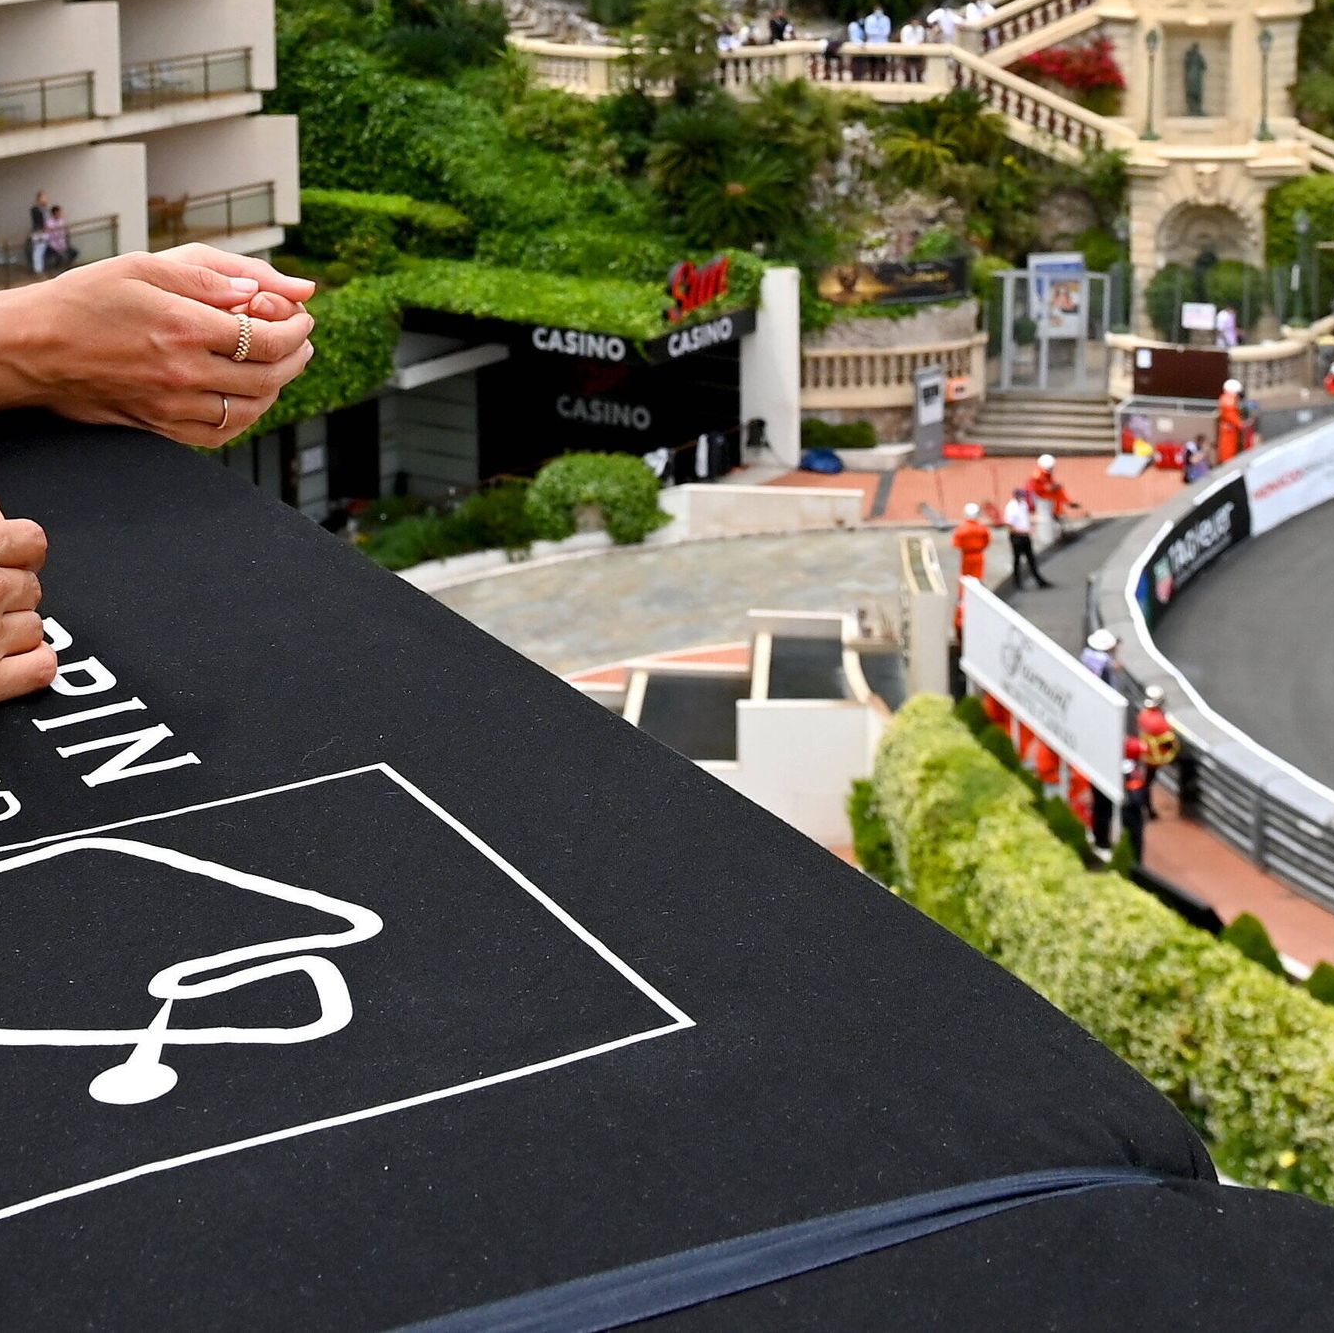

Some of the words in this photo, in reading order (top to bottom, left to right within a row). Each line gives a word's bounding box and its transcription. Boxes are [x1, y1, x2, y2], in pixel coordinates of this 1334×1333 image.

[532, 327, 626, 361] CASINO
[668, 317, 733, 358] CASINO
[556, 395, 651, 431] CASINO
